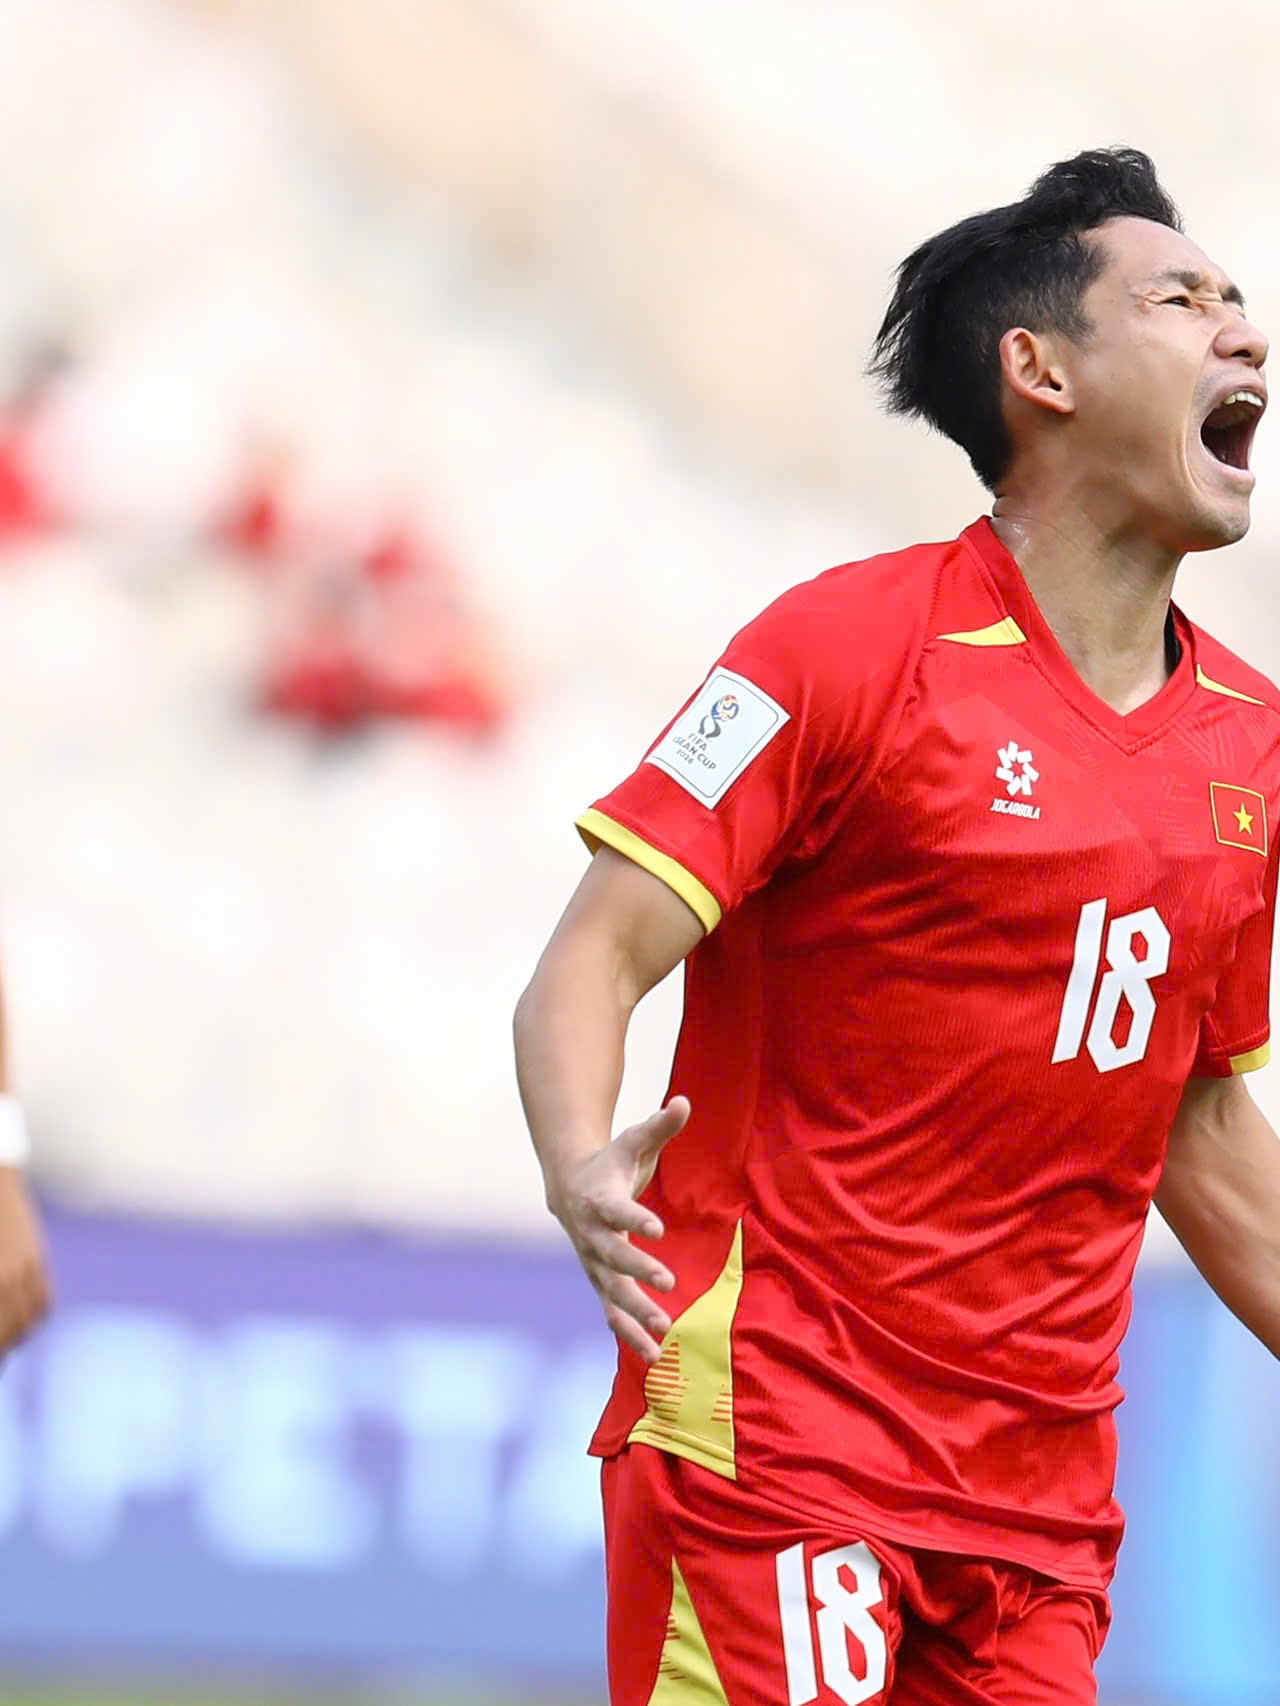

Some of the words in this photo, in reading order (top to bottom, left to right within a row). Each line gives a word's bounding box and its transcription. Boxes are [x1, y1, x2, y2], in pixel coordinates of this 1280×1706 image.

[687, 732, 707, 751] FIFA
[676, 749, 695, 764] 2026
[697, 753, 717, 769] CUP
[1051, 897, 1172, 1073] 18
[775, 1540, 888, 1706] 18
